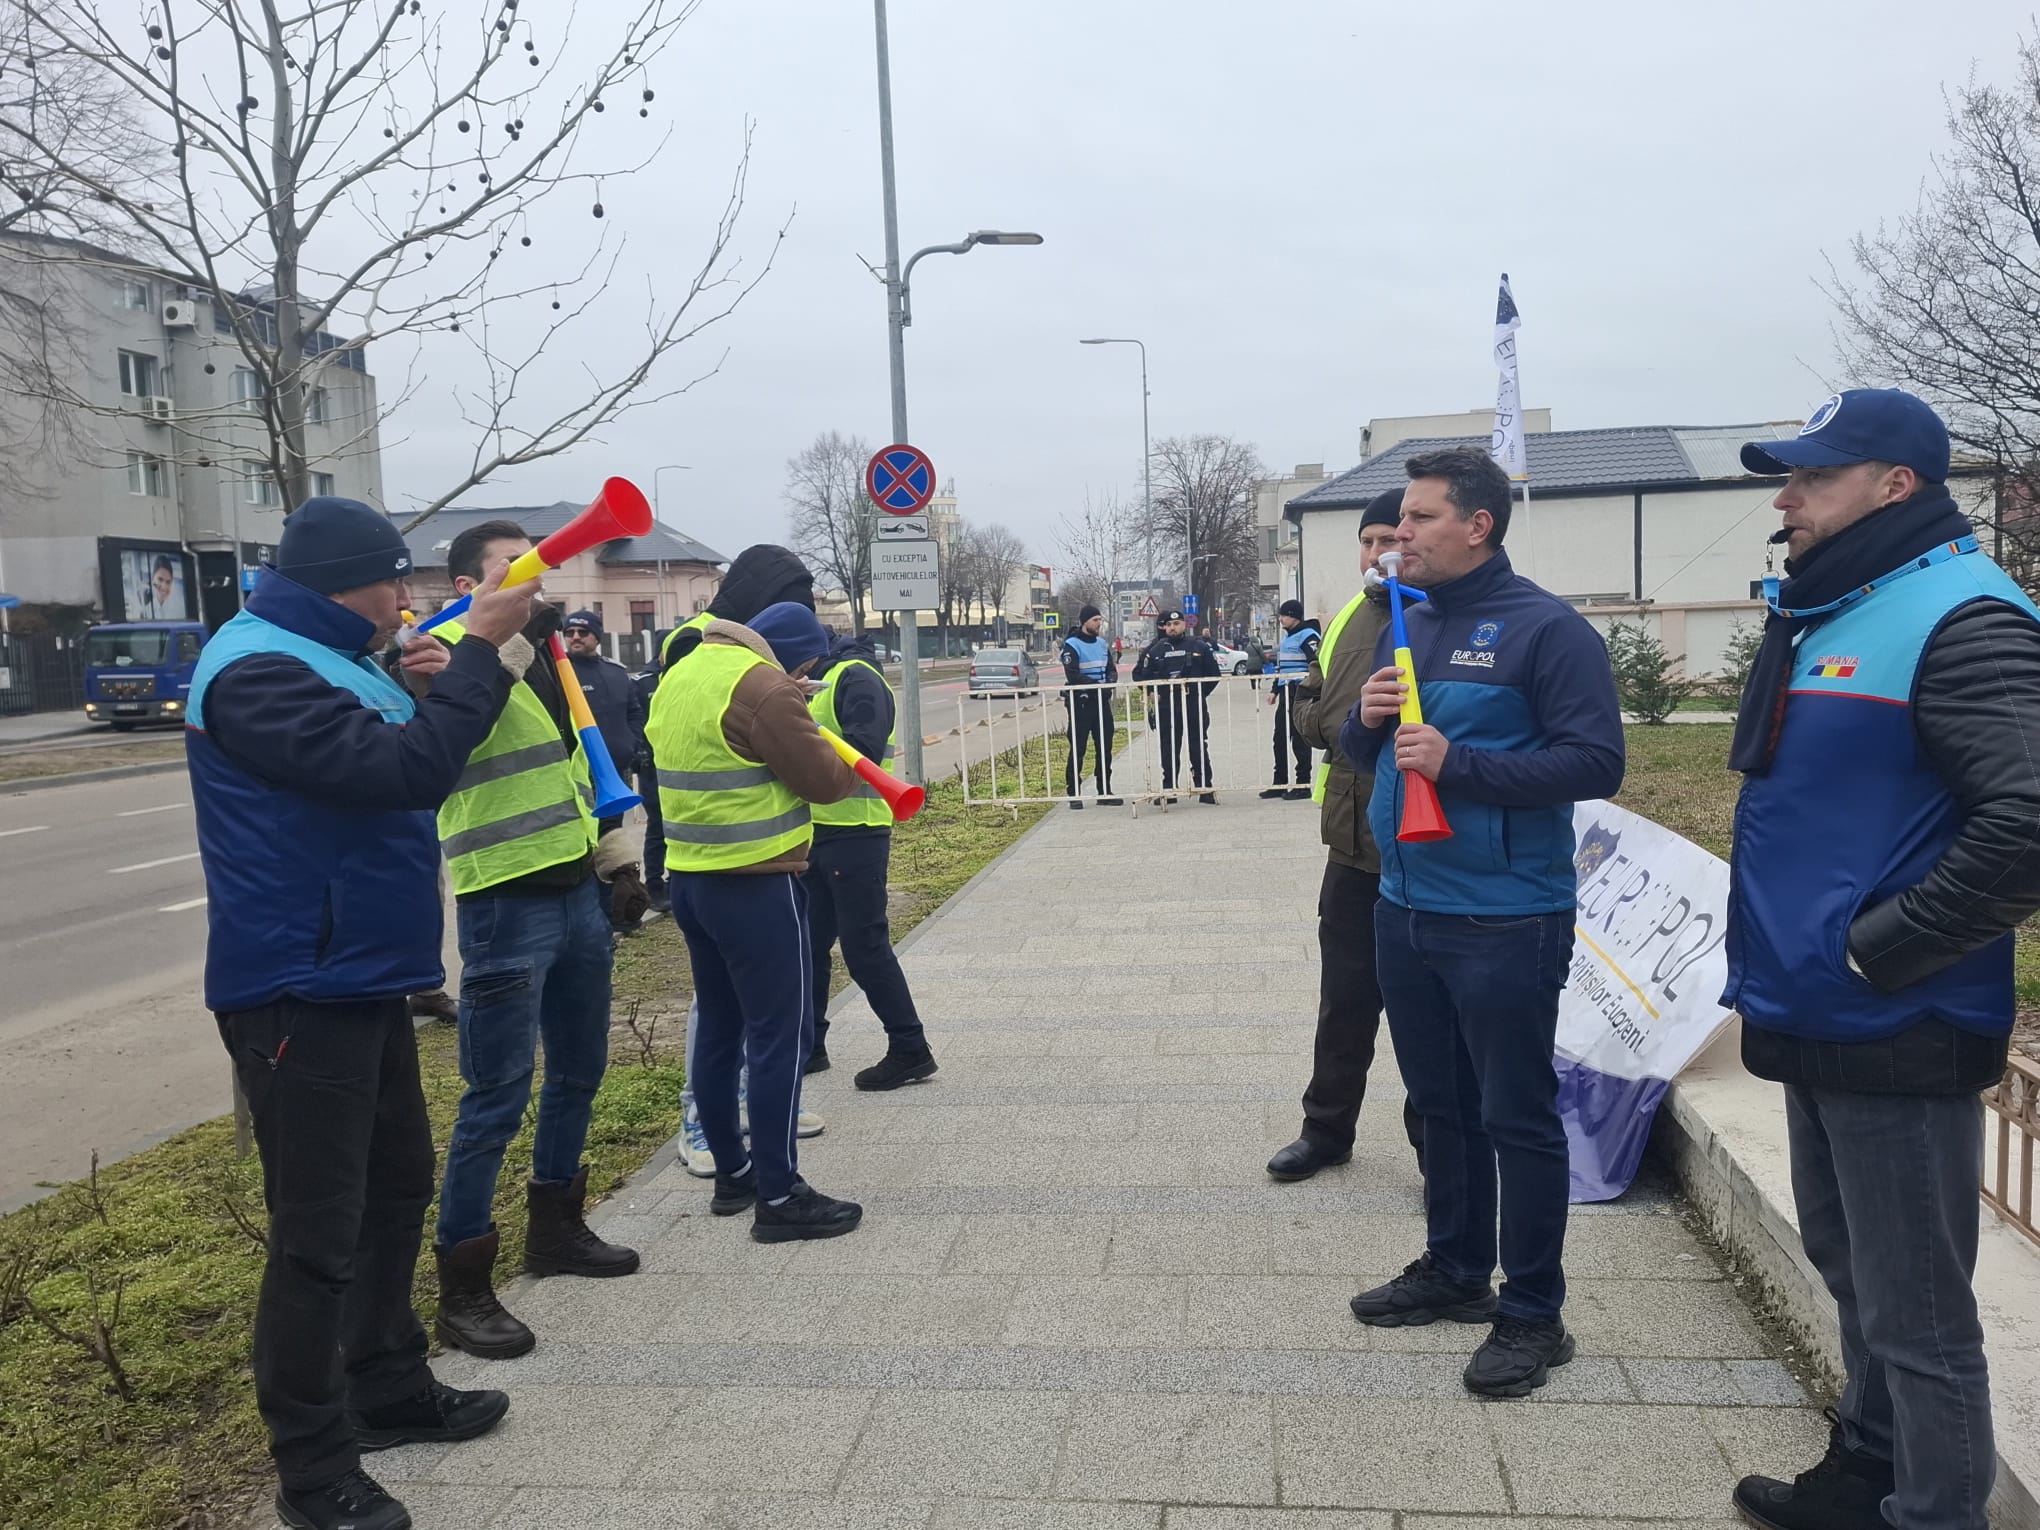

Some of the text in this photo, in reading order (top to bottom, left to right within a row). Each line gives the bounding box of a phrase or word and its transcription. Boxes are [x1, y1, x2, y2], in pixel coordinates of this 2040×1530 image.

[882, 554, 892, 563] CU
[873, 571, 938, 581] AUTOVEHICULELOR
[899, 589, 913, 598] MAI
